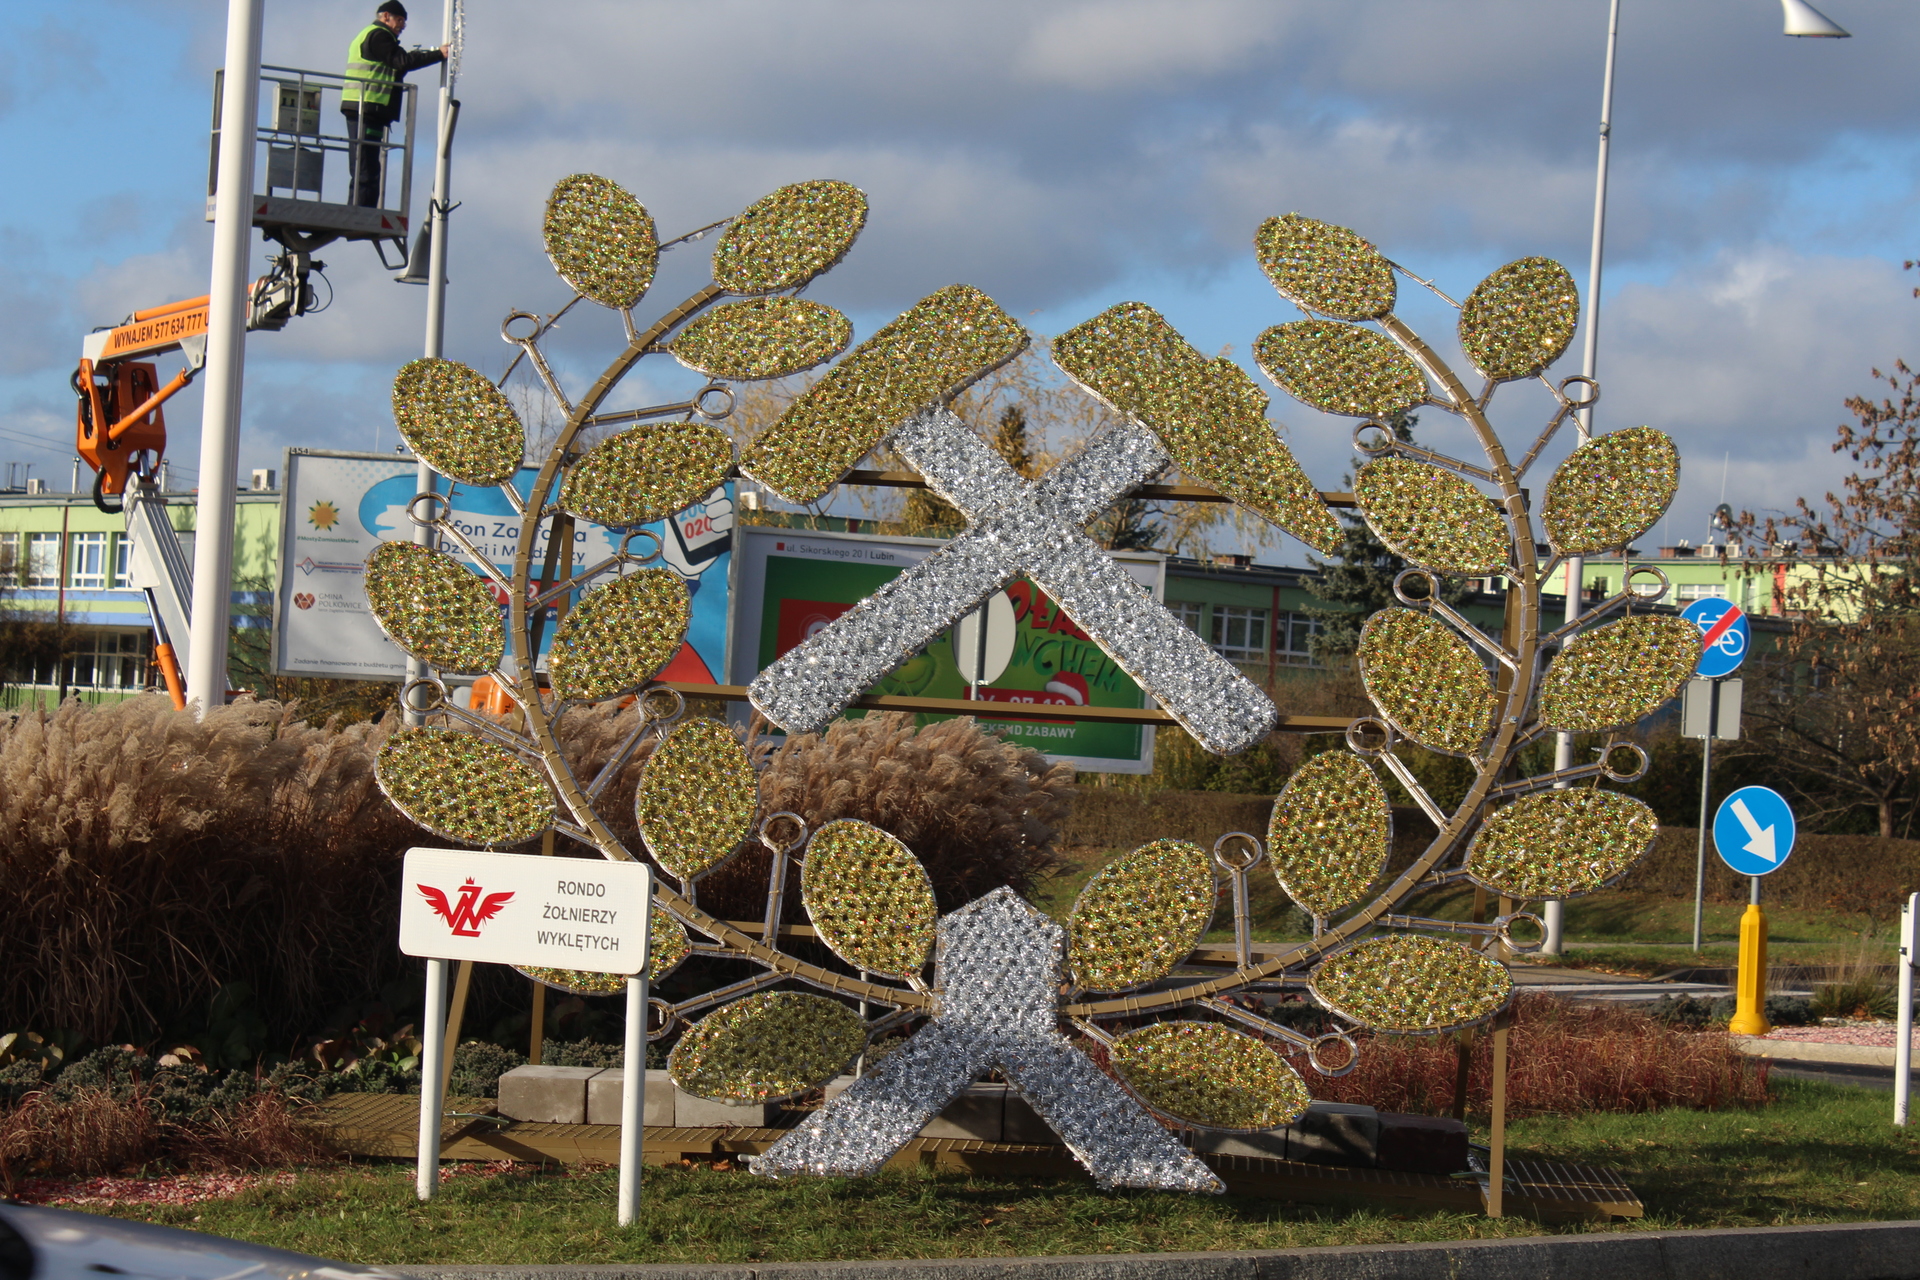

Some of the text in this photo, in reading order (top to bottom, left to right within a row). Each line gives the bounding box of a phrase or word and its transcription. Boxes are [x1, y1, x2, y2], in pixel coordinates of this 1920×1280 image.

[114, 324, 153, 349] WYNAJEM
[154, 319, 169, 340] 577
[170, 315, 185, 336] 634
[186, 312, 202, 332] 777
[786, 544, 797, 553] ul.
[800, 545, 850, 559] Sikorskiego
[852, 549, 862, 558] 20
[870, 551, 895, 561] Lubin
[318, 600, 362, 609] POLKOWICE
[320, 659, 357, 667] finansowane
[363, 661, 388, 669] budżetu
[1025, 725, 1076, 738] ZABAWY
[557, 880, 606, 897] RONDO
[542, 902, 618, 925] ŻOŁNIERZY
[537, 930, 620, 951] WYKLĘTYCH
